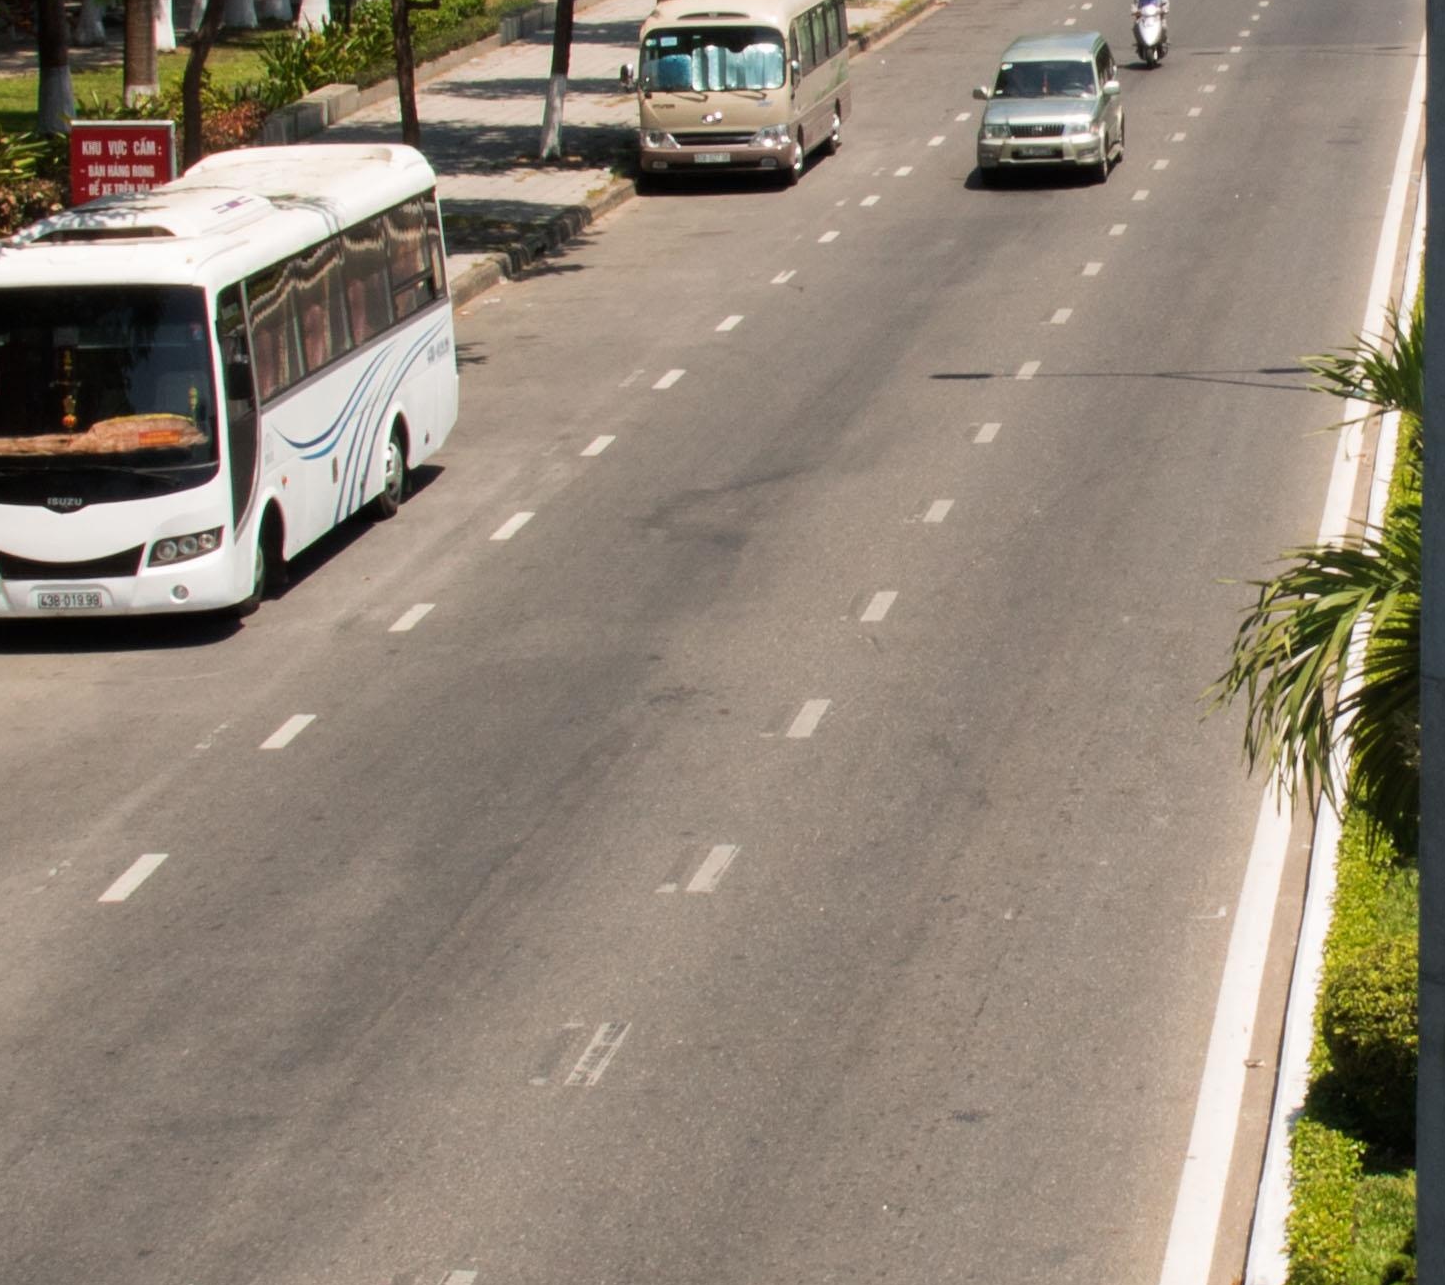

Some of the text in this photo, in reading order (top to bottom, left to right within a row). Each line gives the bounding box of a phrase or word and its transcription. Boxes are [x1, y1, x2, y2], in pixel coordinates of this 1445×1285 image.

[82, 140, 102, 155] KHU
[108, 139, 127, 159] VỰC
[47, 497, 82, 506] ISUZU
